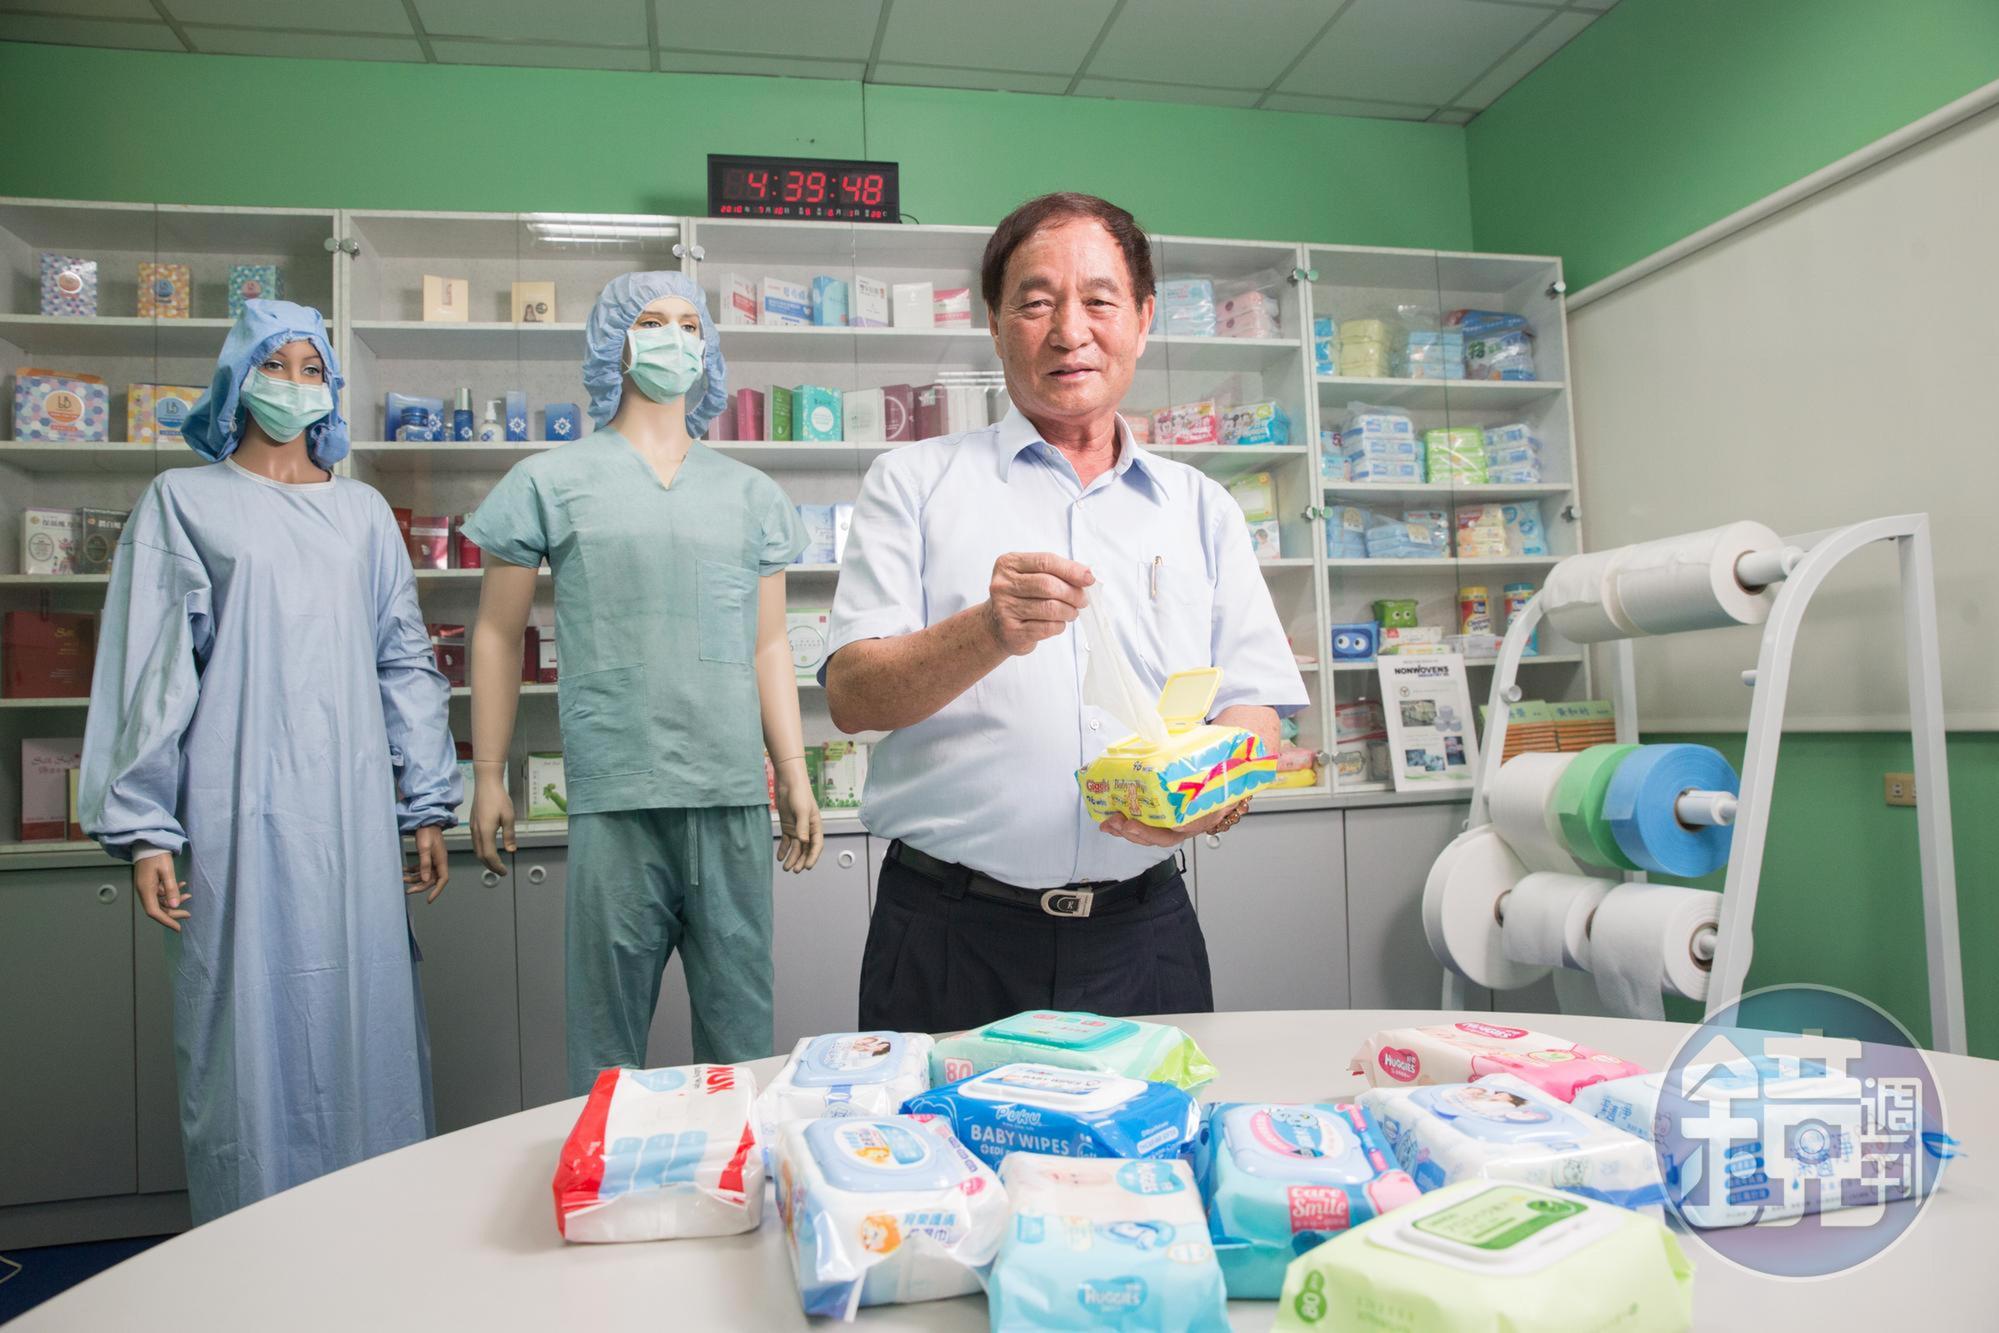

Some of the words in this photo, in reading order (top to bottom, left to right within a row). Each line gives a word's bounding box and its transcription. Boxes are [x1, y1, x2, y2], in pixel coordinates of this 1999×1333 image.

[747, 171, 884, 205] 4:39:48
[1394, 664, 1450, 675] NONWOVENS
[706, 1066, 735, 1095] NUK
[946, 1062, 972, 1083] 80
[970, 1124, 1016, 1146] BABY
[1018, 1134, 1070, 1156] WIPES
[1292, 1198, 1347, 1218] Smile
